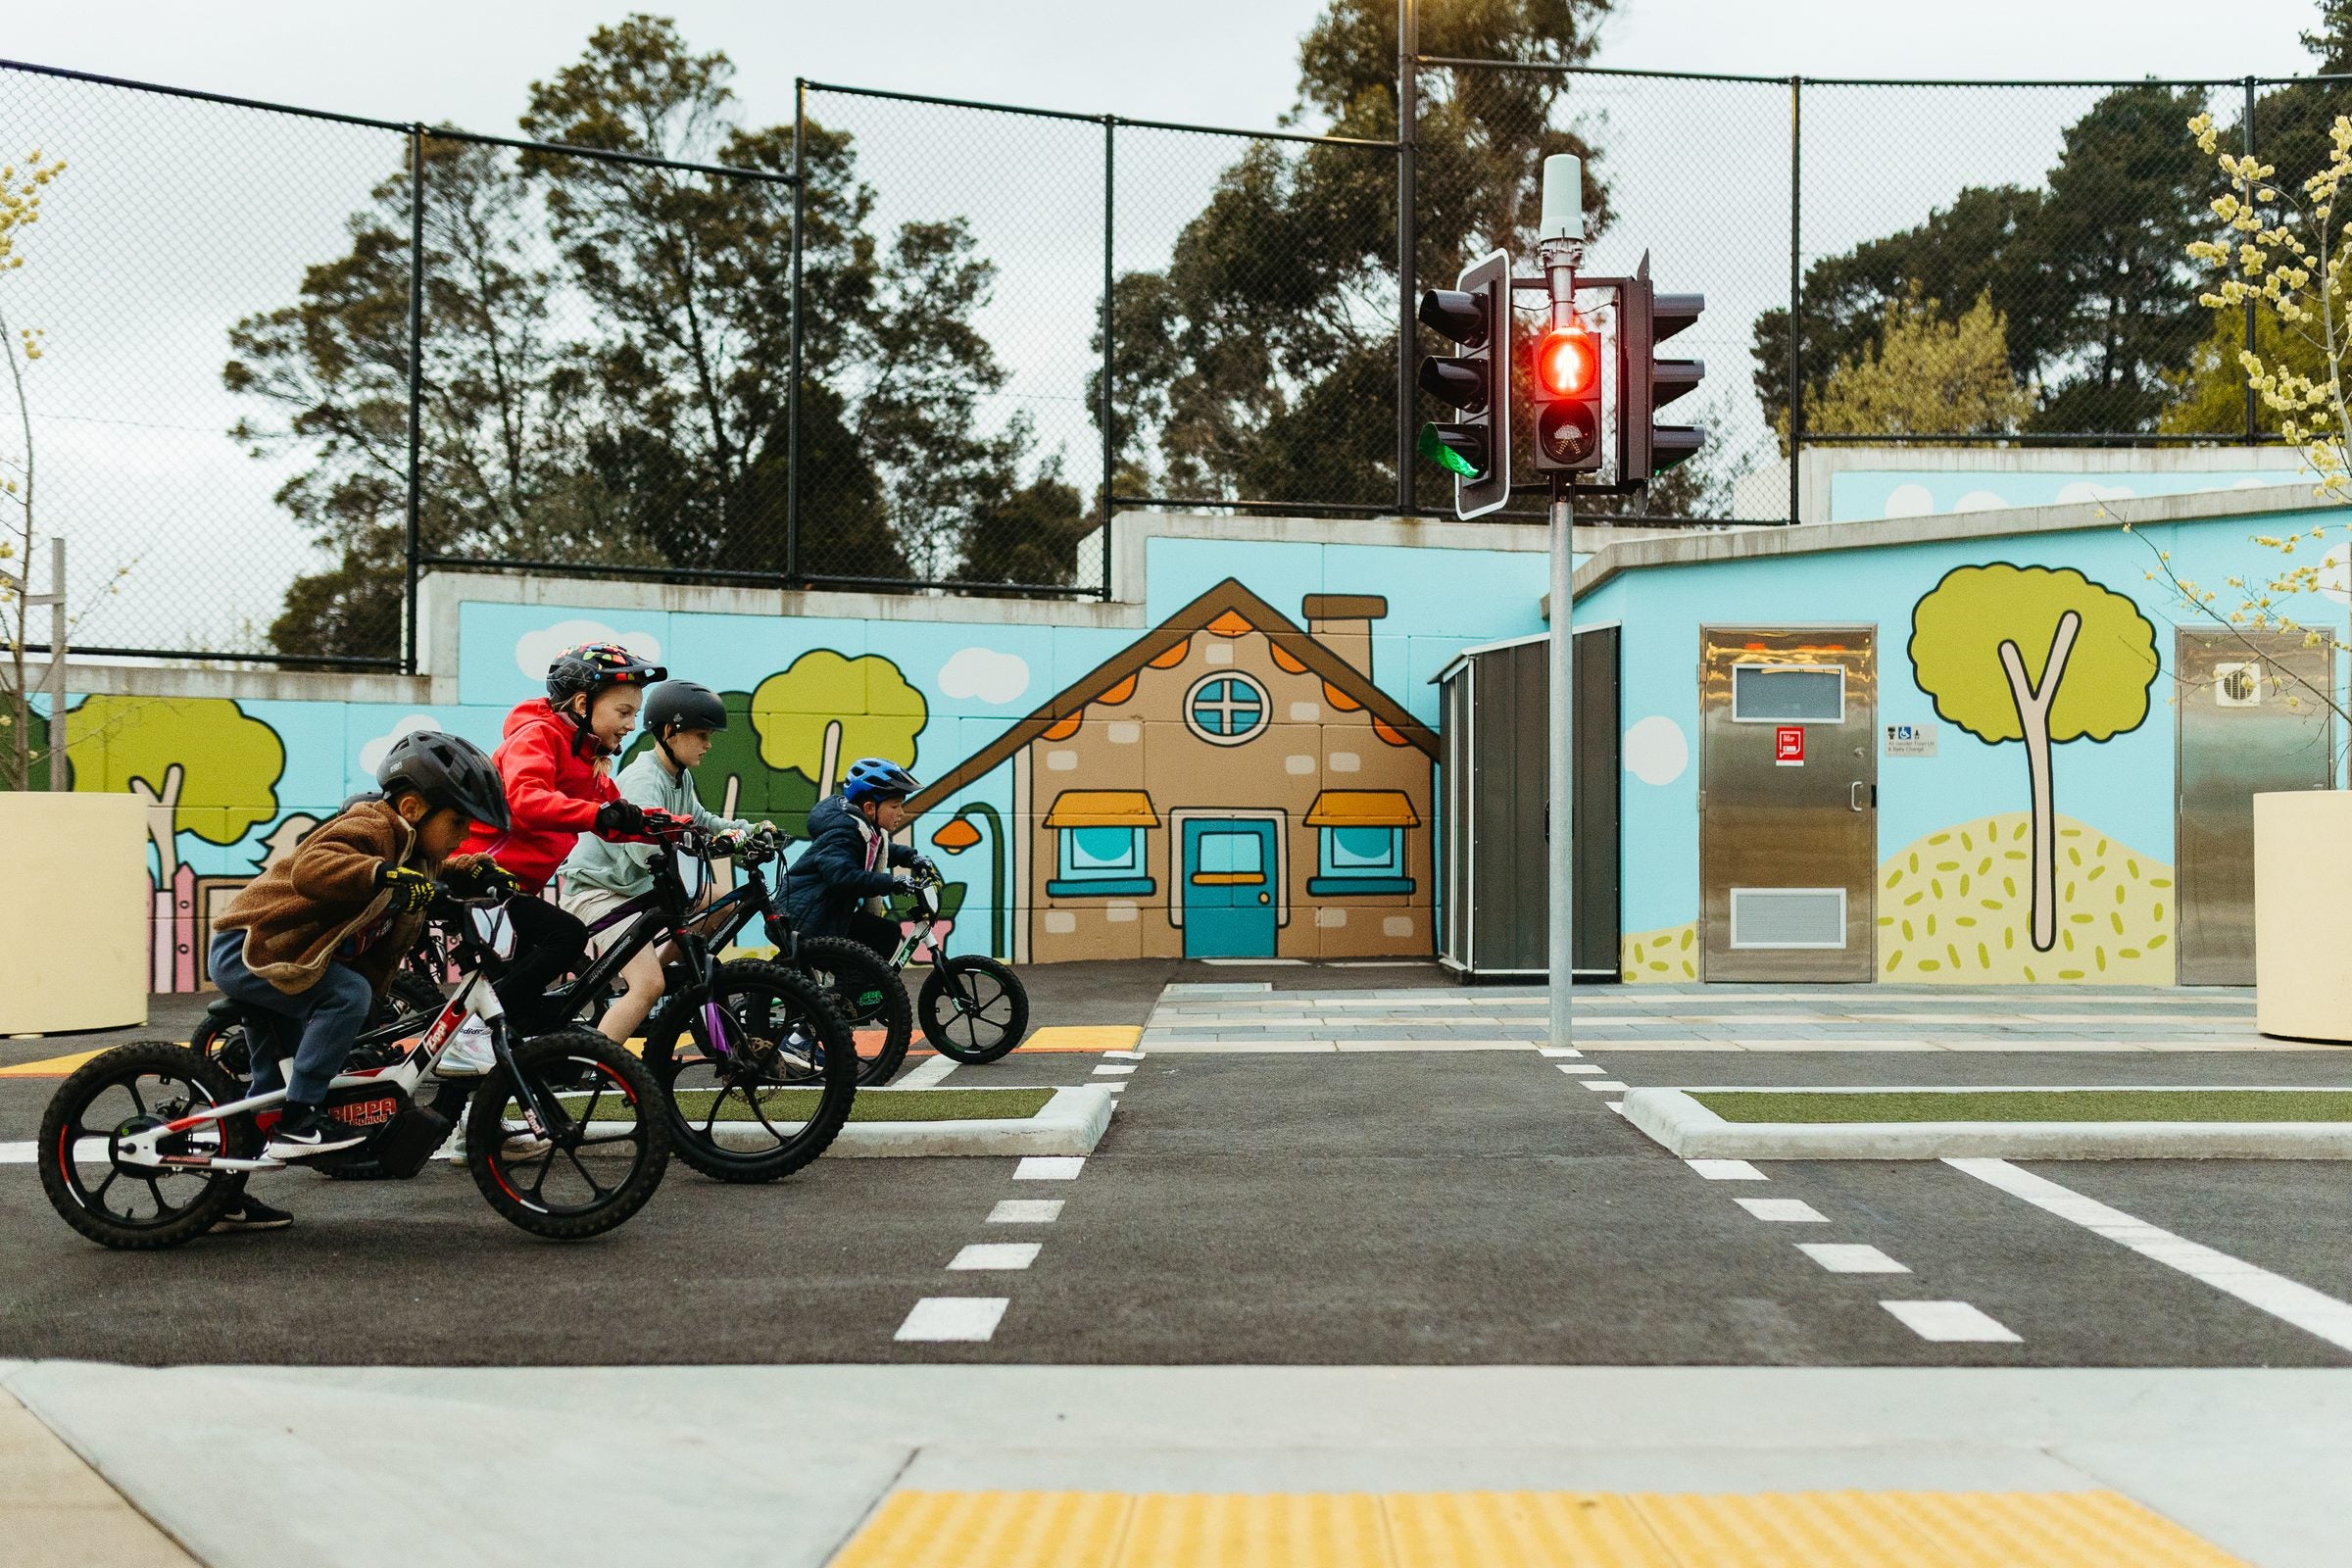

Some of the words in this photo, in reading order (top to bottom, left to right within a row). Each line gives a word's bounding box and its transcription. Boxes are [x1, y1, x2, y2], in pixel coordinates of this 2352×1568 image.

[426, 1020, 448, 1052] Zippi
[328, 1098, 396, 1123] RIPPA
[524, 1108, 546, 1135] Zippi
